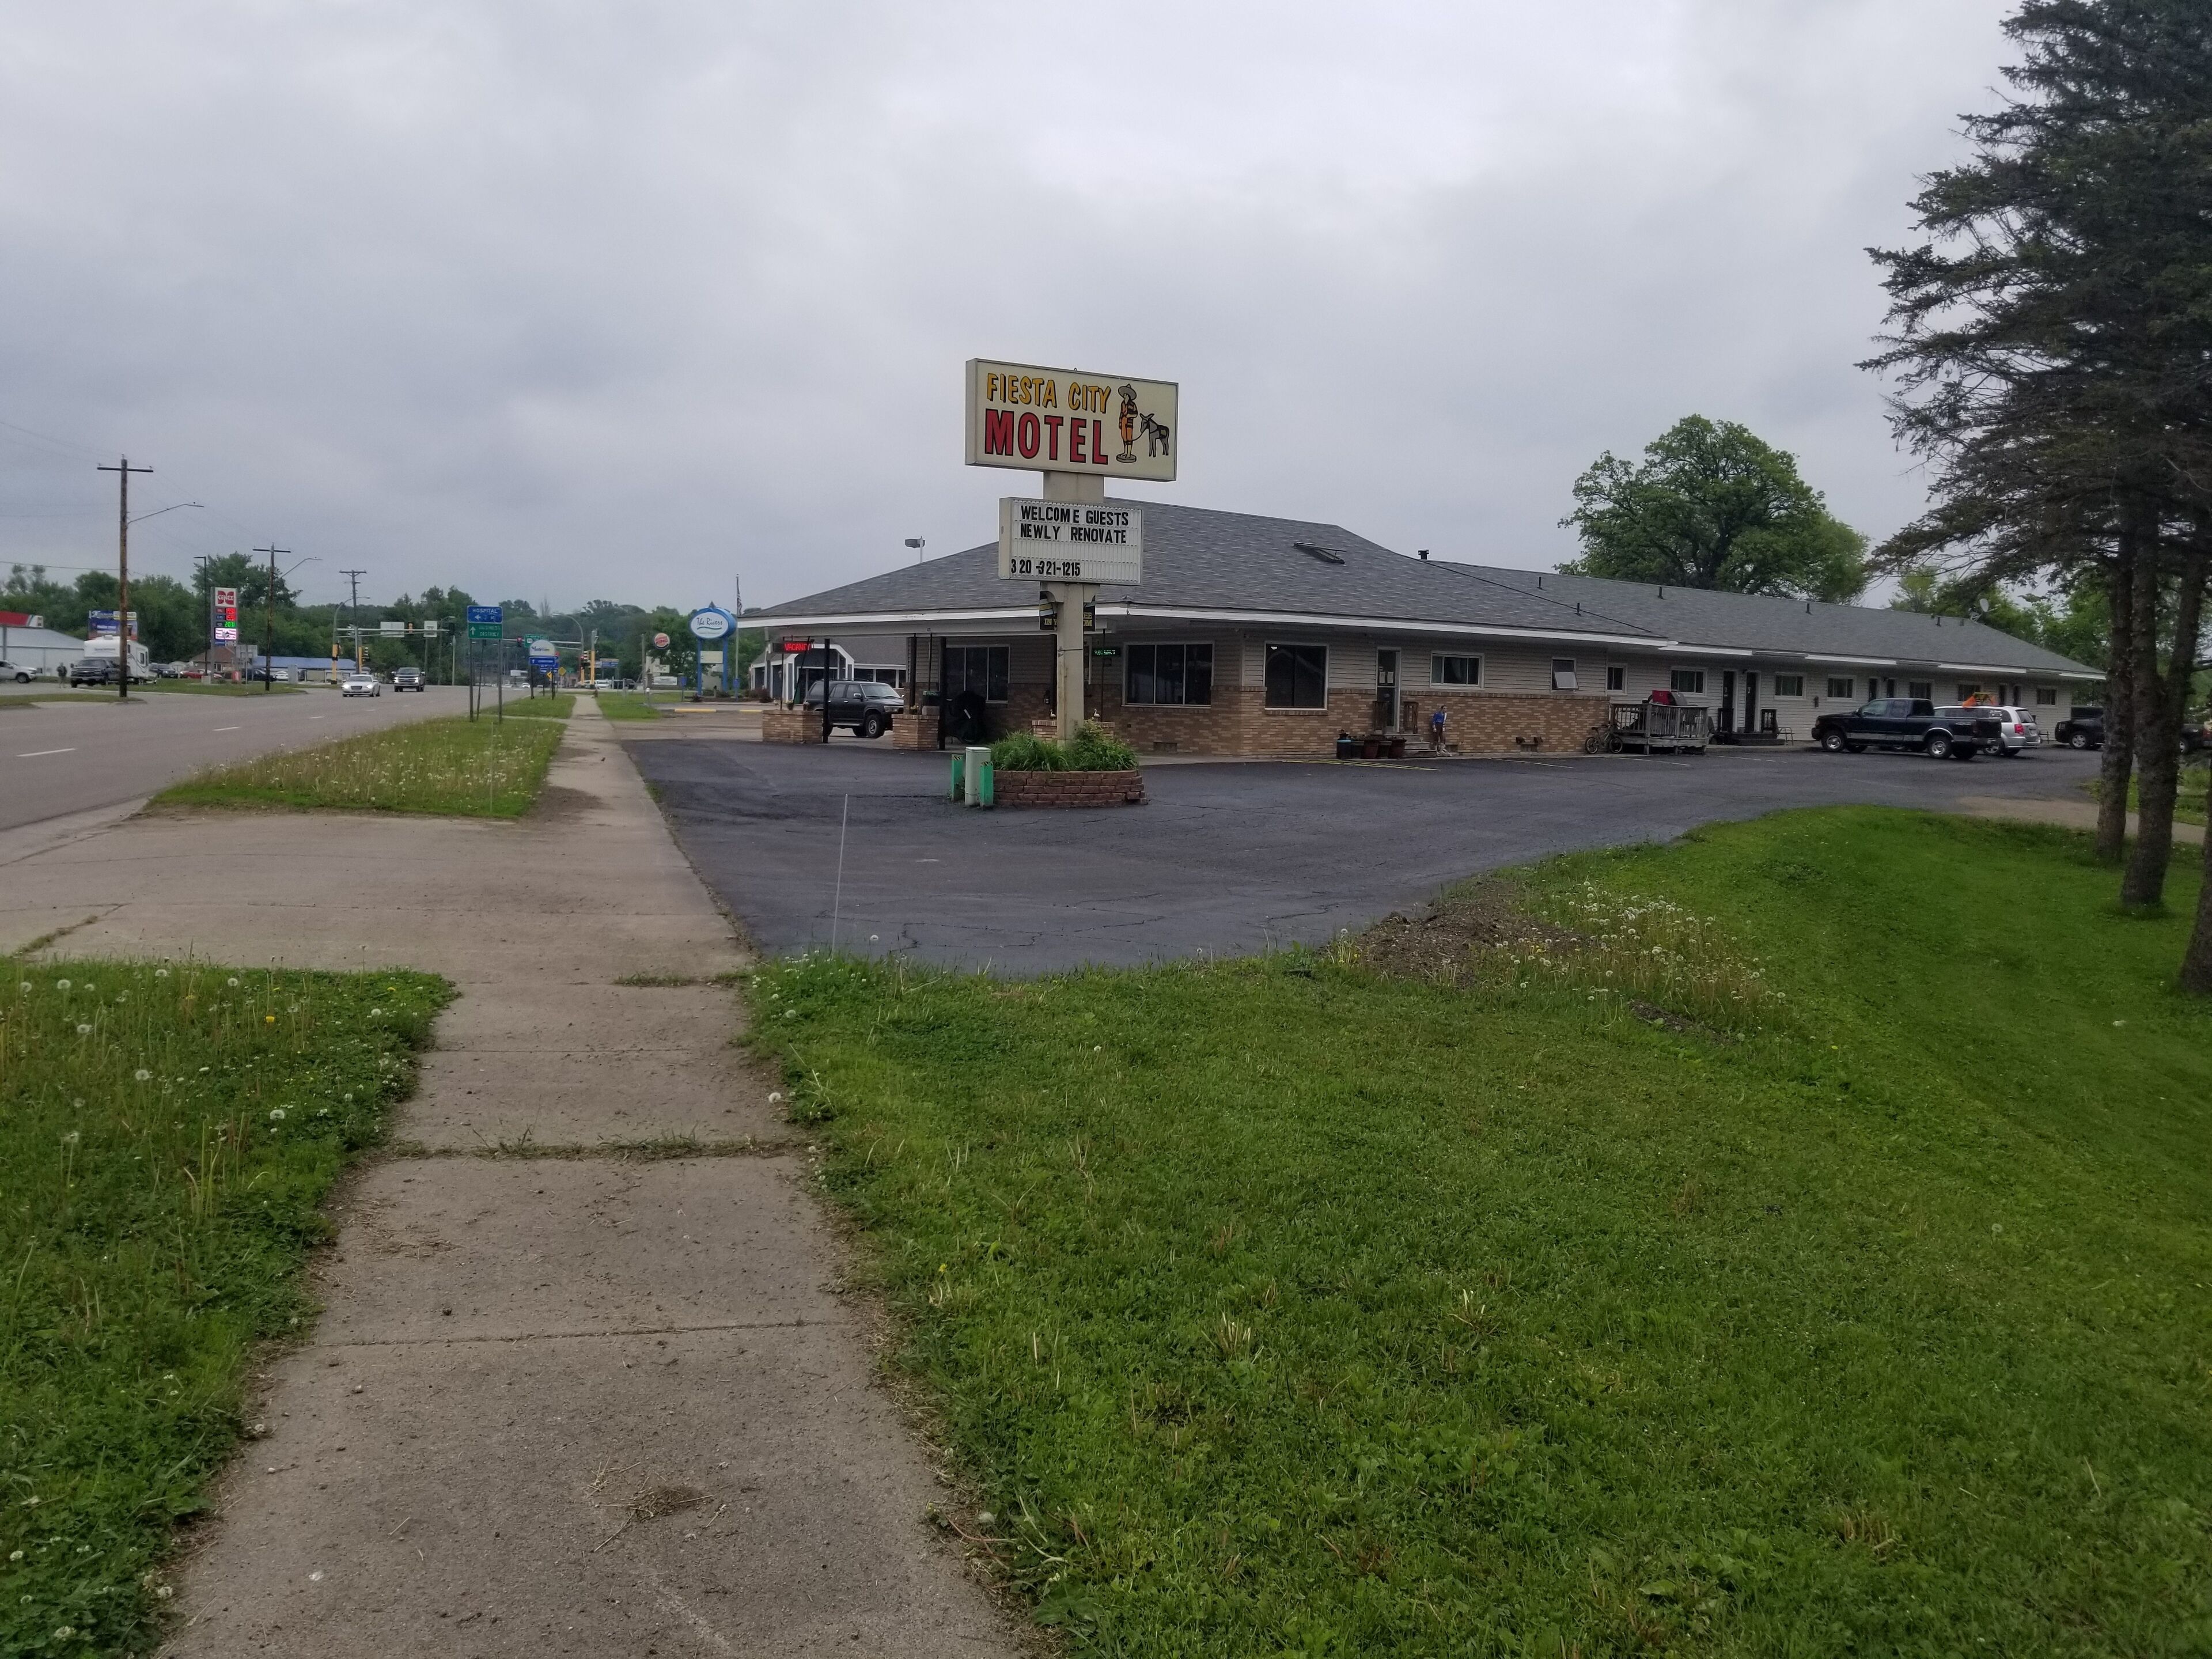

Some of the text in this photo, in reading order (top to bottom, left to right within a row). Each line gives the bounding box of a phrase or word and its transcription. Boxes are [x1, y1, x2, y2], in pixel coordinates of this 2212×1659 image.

[987, 373, 1111, 414] FIESTA CITY
[984, 408, 1108, 465] MOTEL
[1021, 505, 1129, 526] WELCOME GUESTS
[1020, 523, 1126, 544] NEWLY RENOVATE
[706, 618, 723, 626] Rivers
